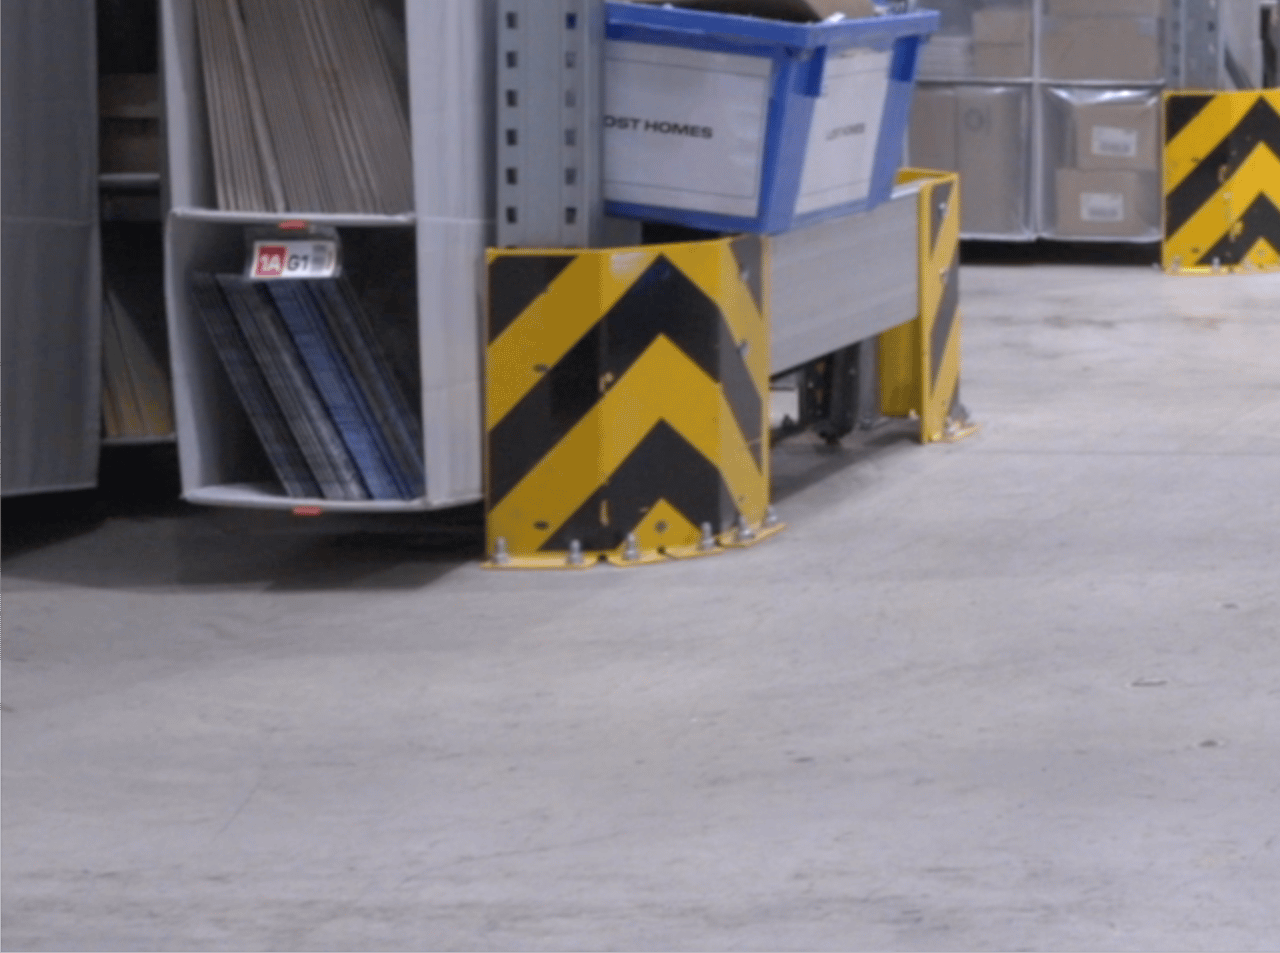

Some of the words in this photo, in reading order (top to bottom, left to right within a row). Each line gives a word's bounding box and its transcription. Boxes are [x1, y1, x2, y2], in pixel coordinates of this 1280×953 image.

[602, 114, 641, 131] OST
[643, 119, 714, 140] HOMES
[287, 254, 310, 272] G1
